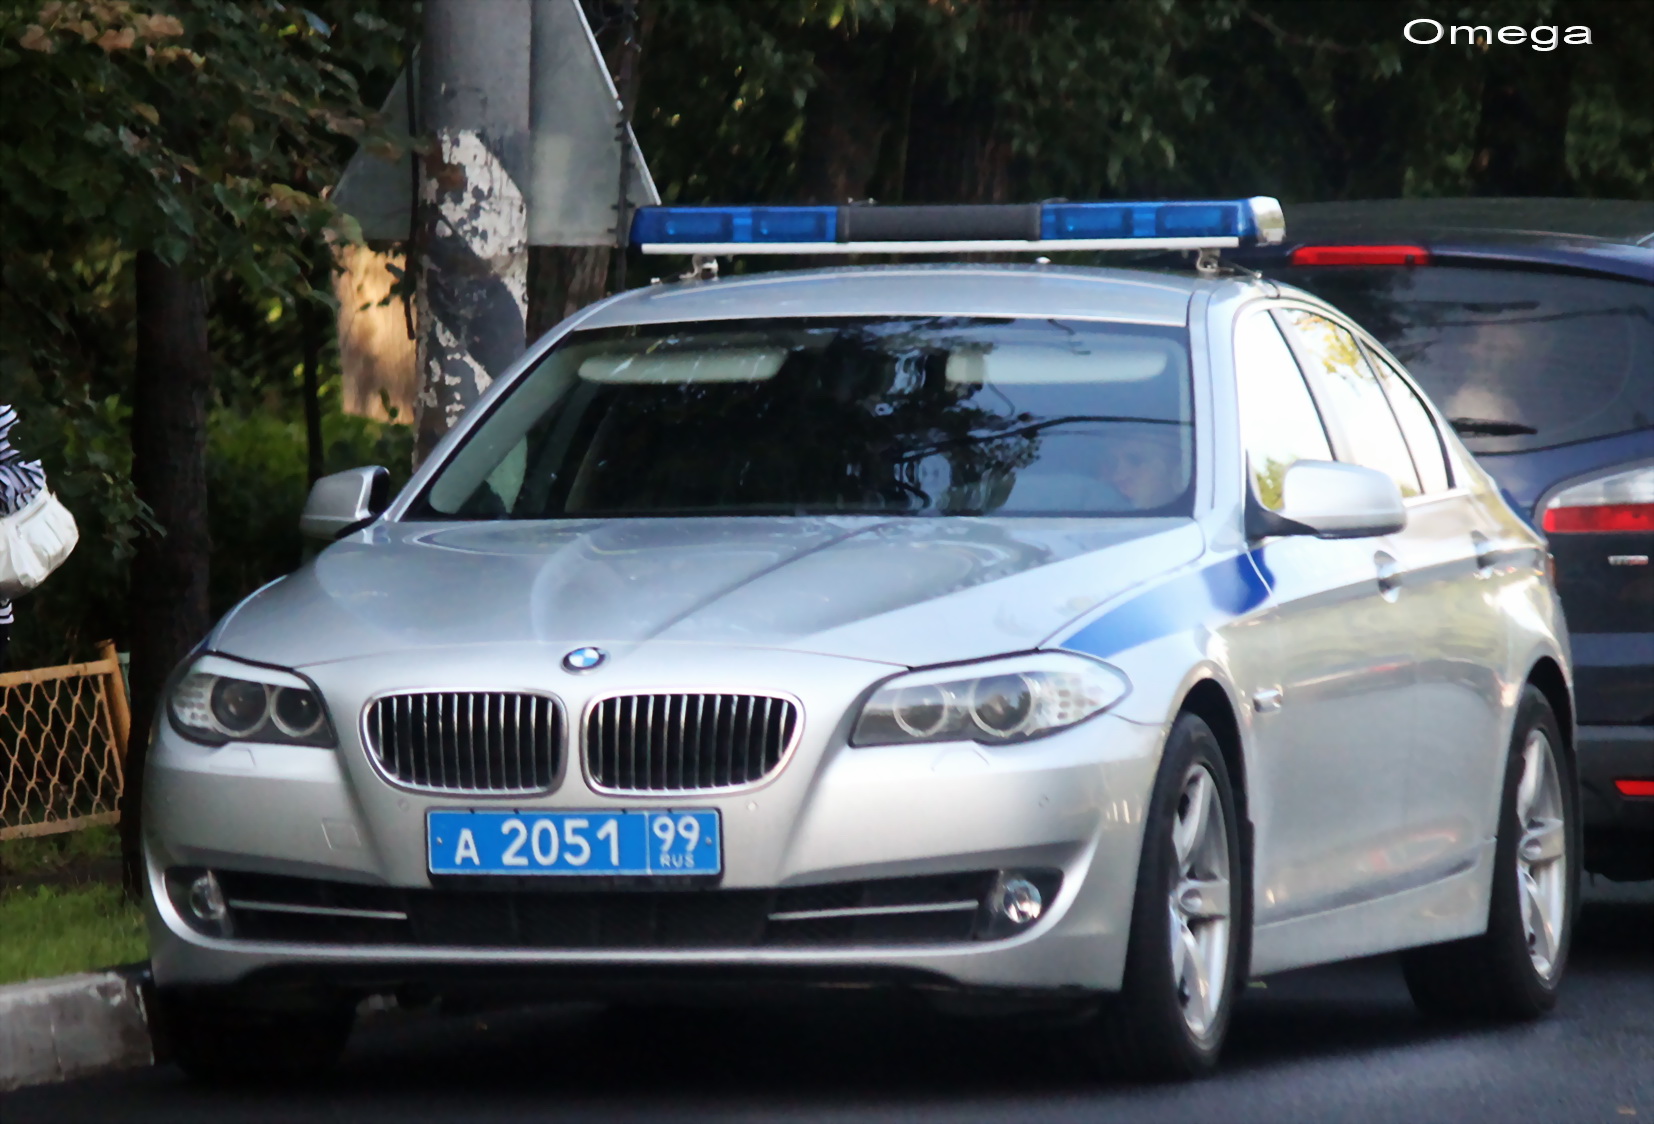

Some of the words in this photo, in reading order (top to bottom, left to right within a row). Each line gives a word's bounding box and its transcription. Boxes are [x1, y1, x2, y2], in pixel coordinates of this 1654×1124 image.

[454, 828, 480, 866] A
[501, 818, 620, 867] 2051
[652, 815, 701, 852] 99
[660, 853, 695, 869] RUS
